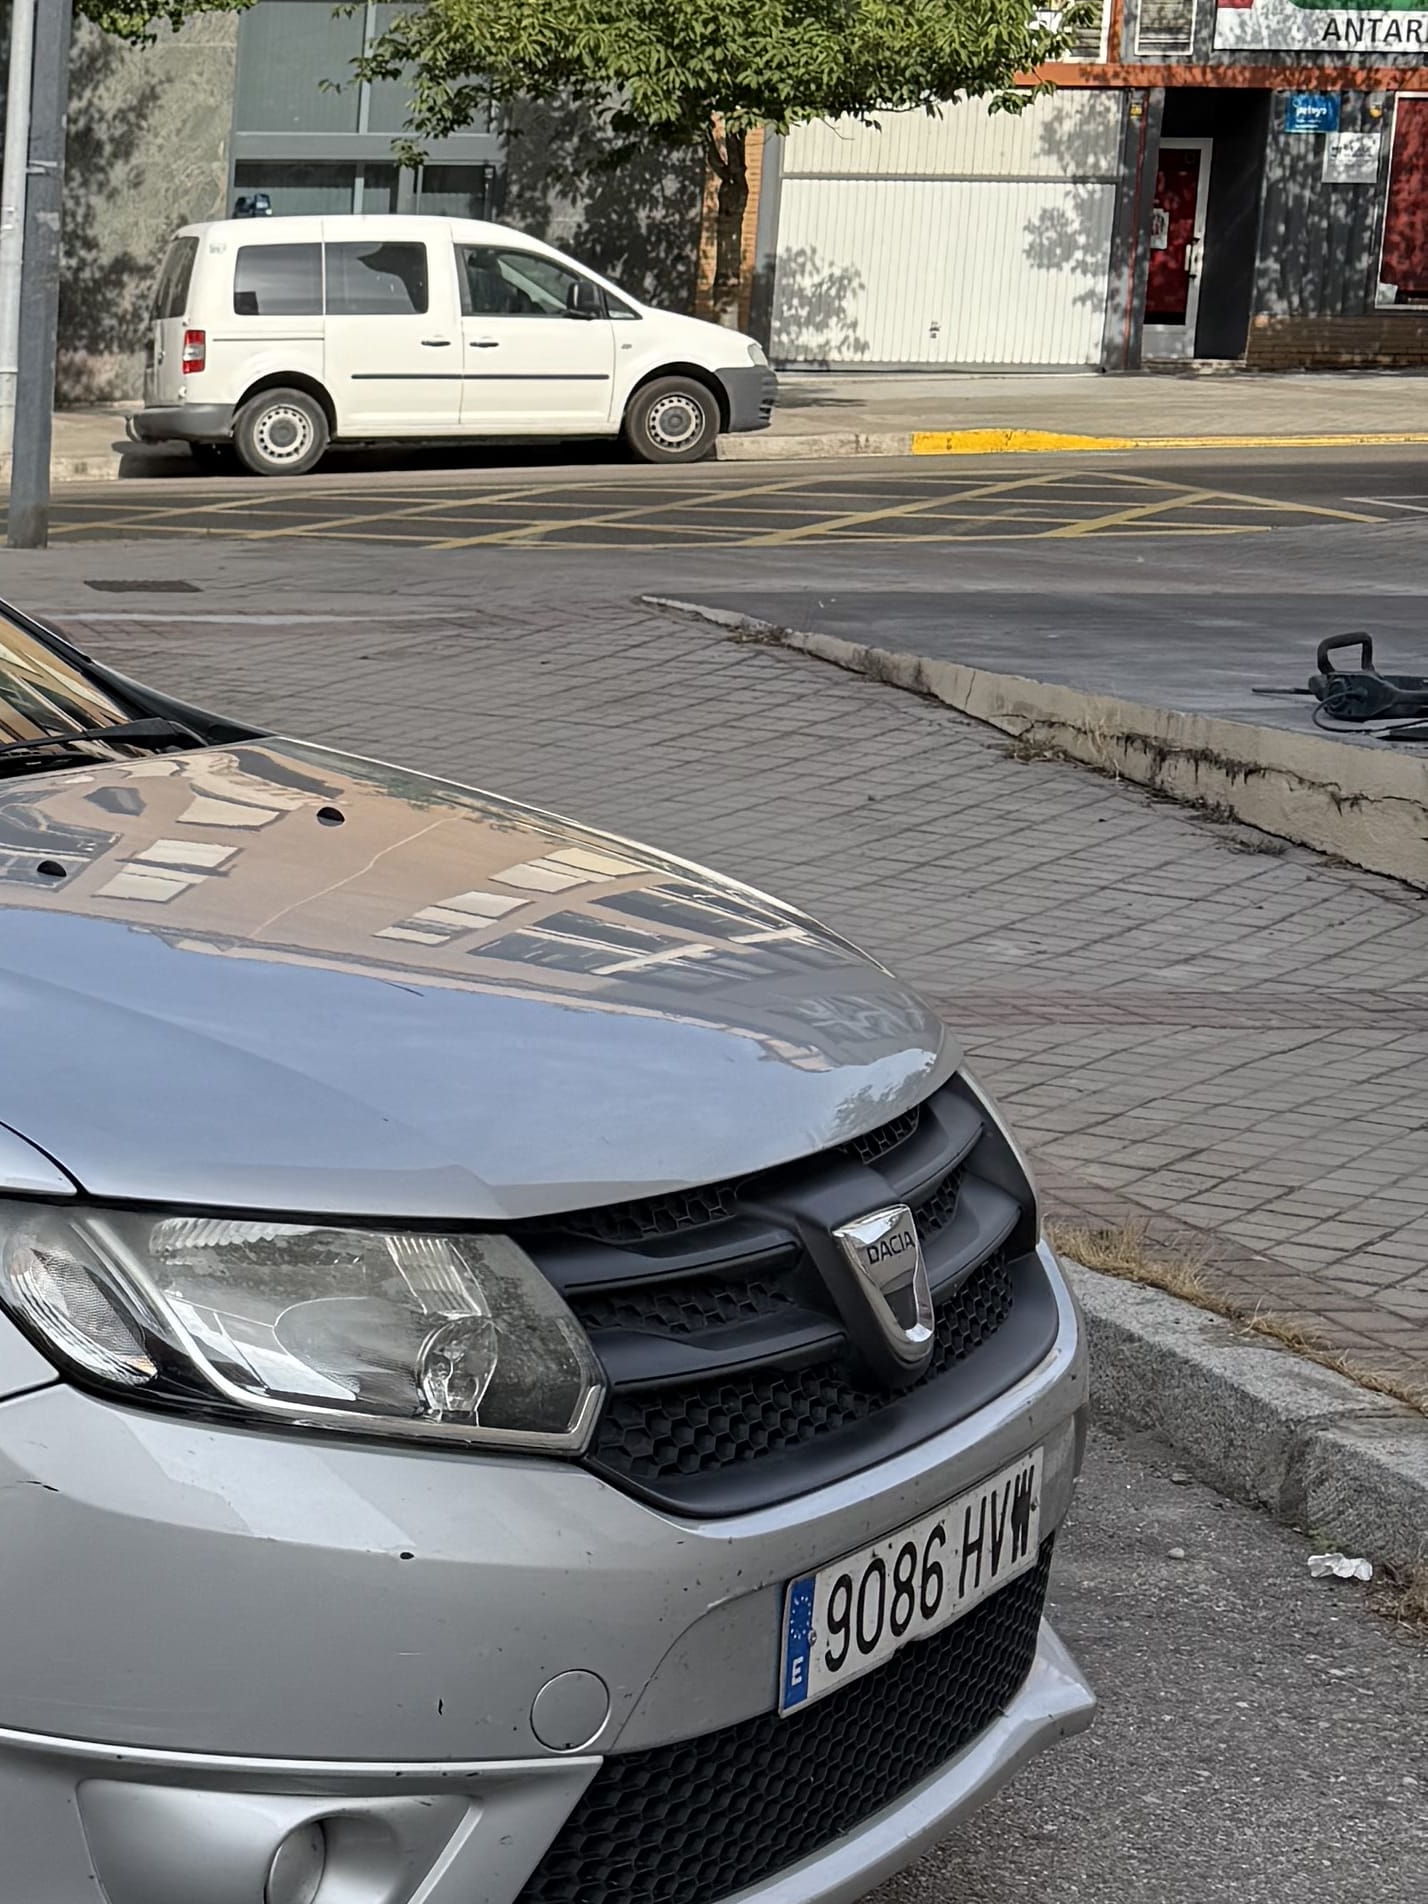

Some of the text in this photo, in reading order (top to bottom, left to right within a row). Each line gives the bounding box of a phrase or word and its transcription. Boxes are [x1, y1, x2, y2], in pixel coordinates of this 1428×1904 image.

[1321, 17, 1428, 43] ANTAR
[867, 1231, 915, 1264] DACIA
[825, 1464, 1035, 1673] 9086 HVW
[791, 1655, 804, 1687] E
